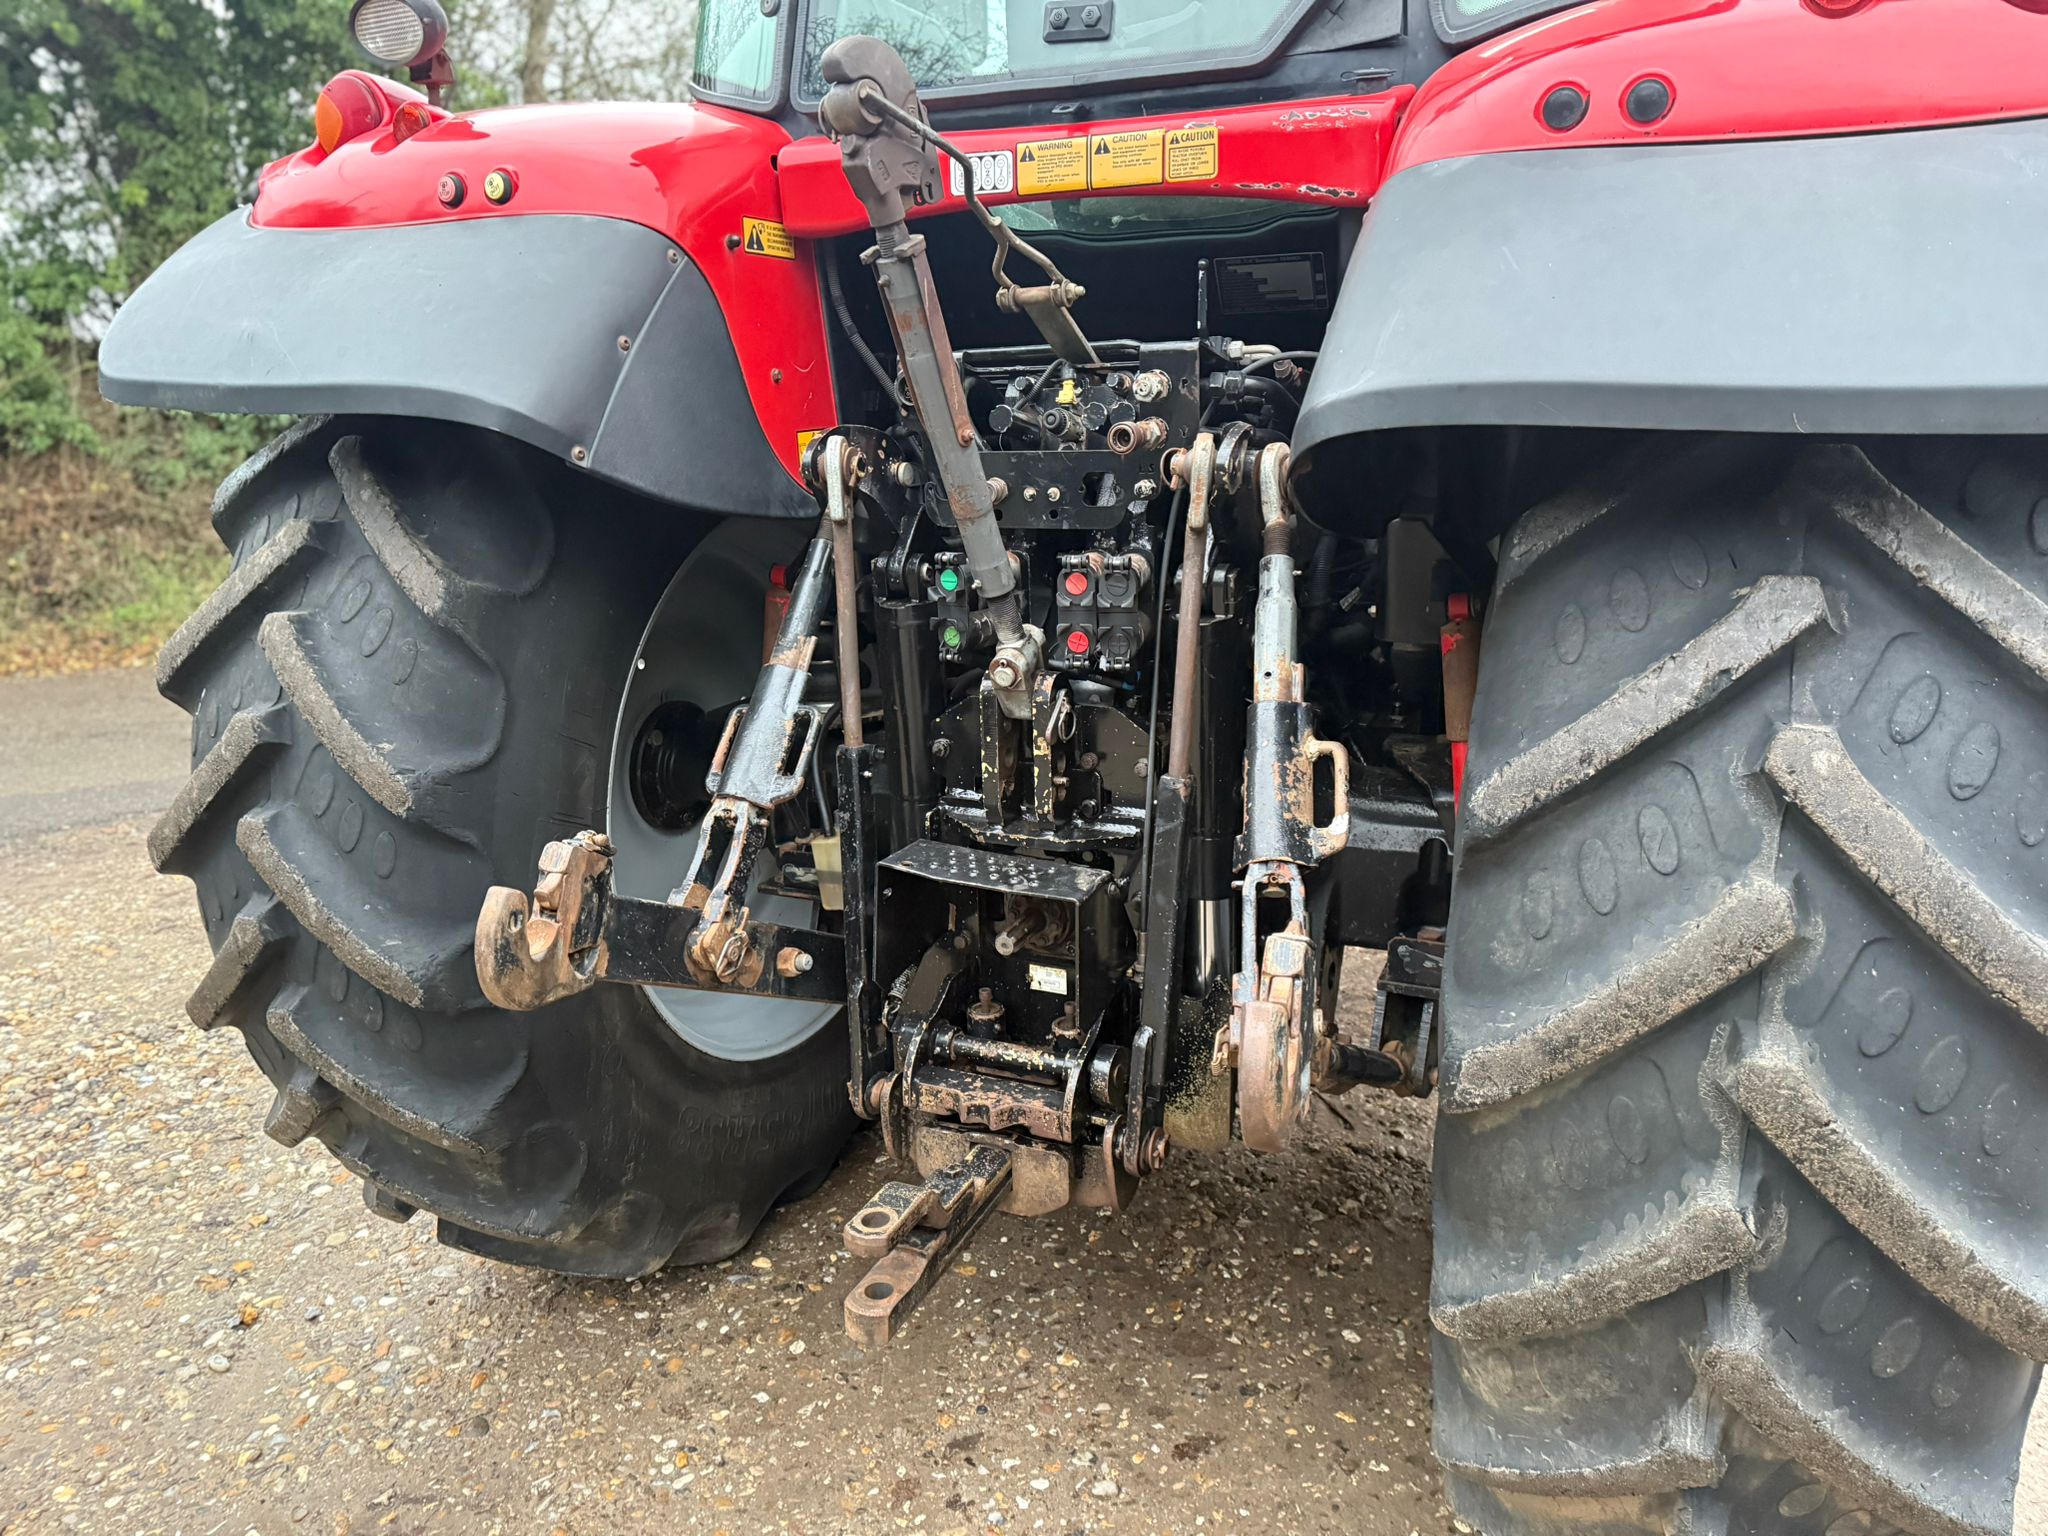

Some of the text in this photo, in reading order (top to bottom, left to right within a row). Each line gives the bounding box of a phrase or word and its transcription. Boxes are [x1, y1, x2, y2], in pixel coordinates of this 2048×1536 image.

[1112, 133, 1147, 143] CAUTION
[1181, 130, 1214, 142] CAUTION
[1037, 141, 1072, 151] WARNING
